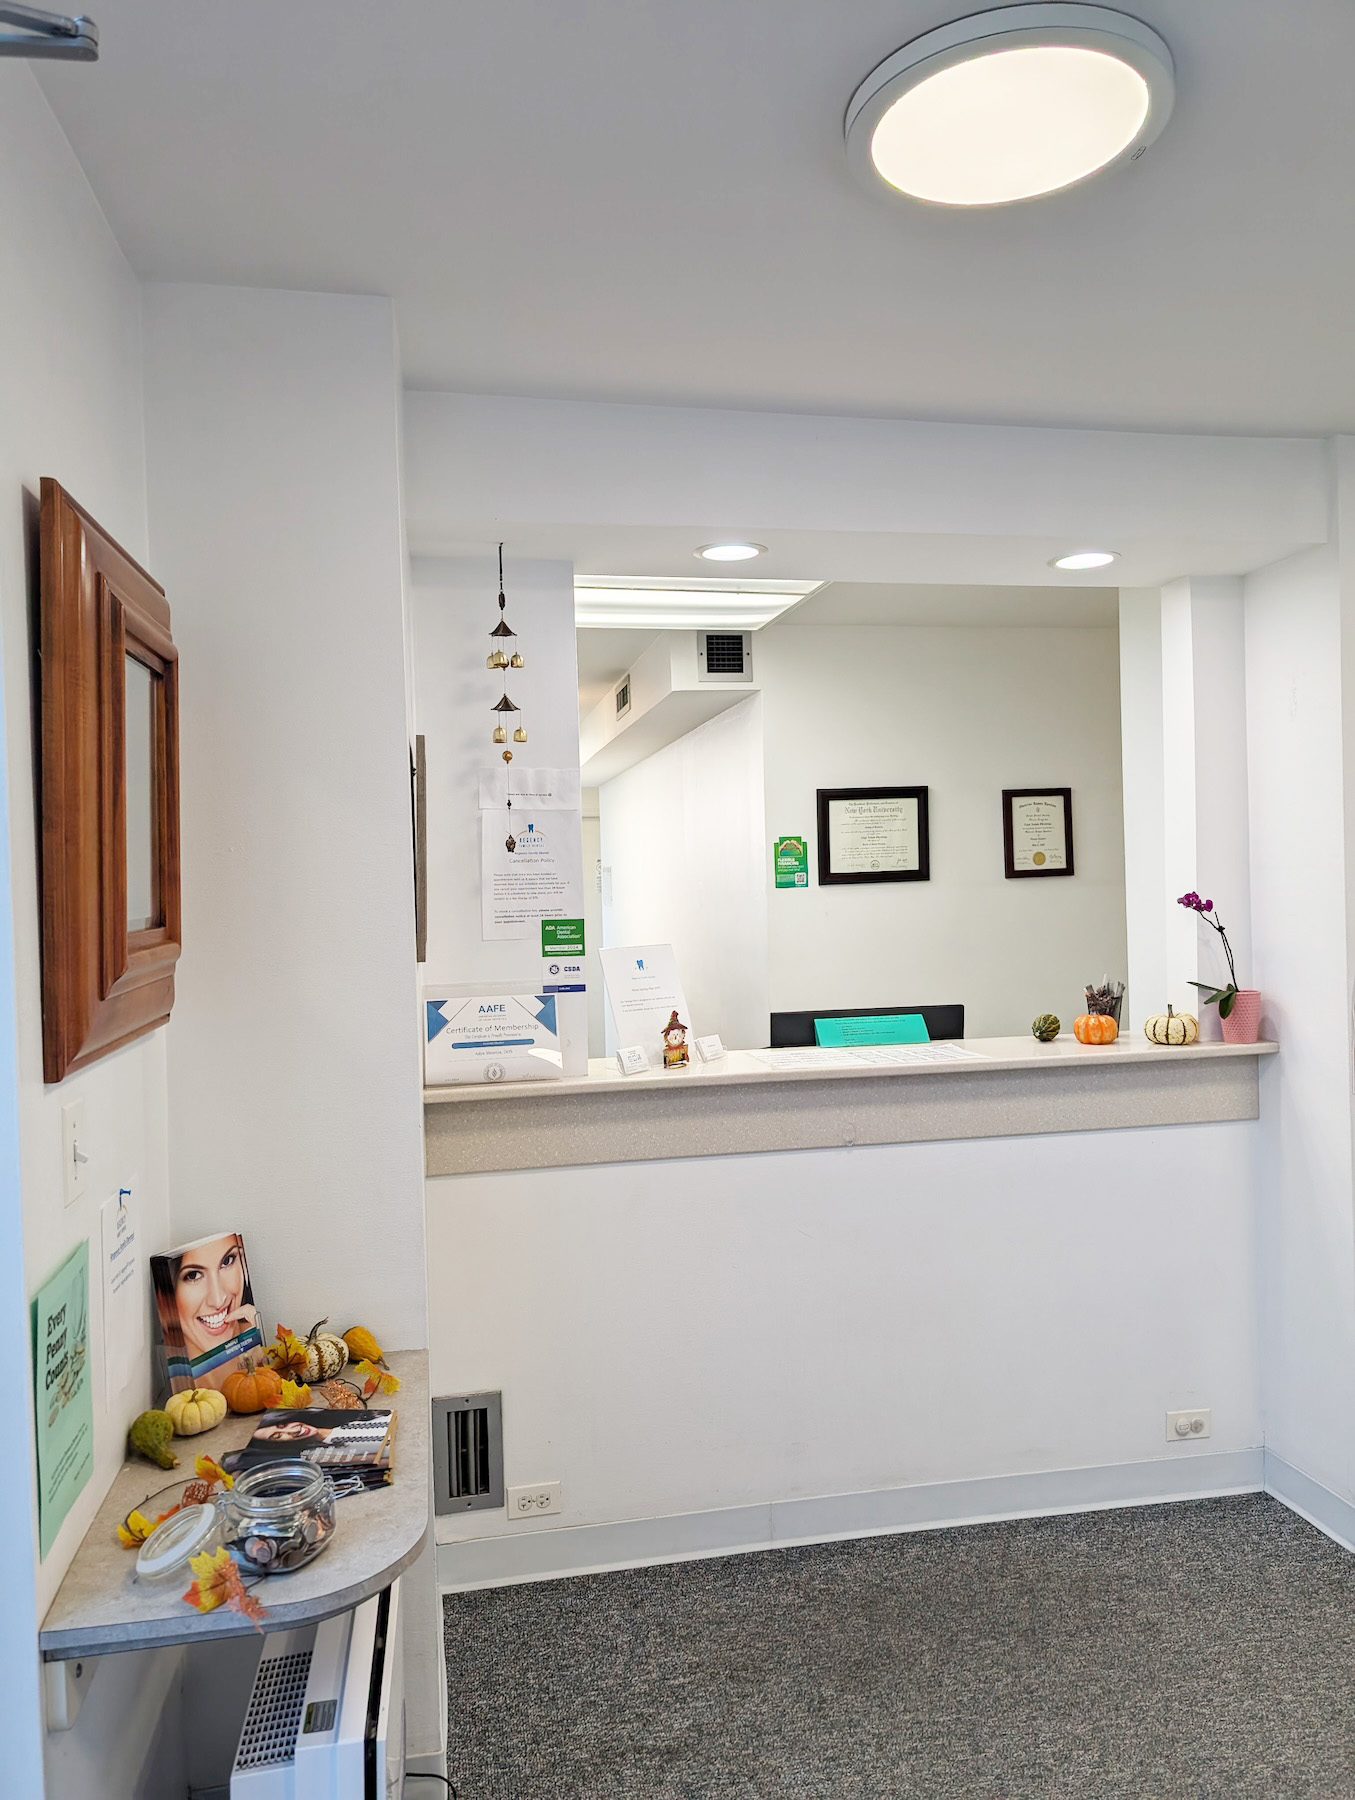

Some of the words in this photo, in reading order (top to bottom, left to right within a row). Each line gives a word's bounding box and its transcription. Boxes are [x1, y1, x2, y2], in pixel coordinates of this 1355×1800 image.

[478, 1004, 506, 1013] AAFE
[446, 1026, 483, 1035] Certificate
[494, 1023, 539, 1031] Membership
[47, 1302, 67, 1338] Every
[46, 1327, 68, 1365] Penny
[45, 1351, 69, 1391] Counts
